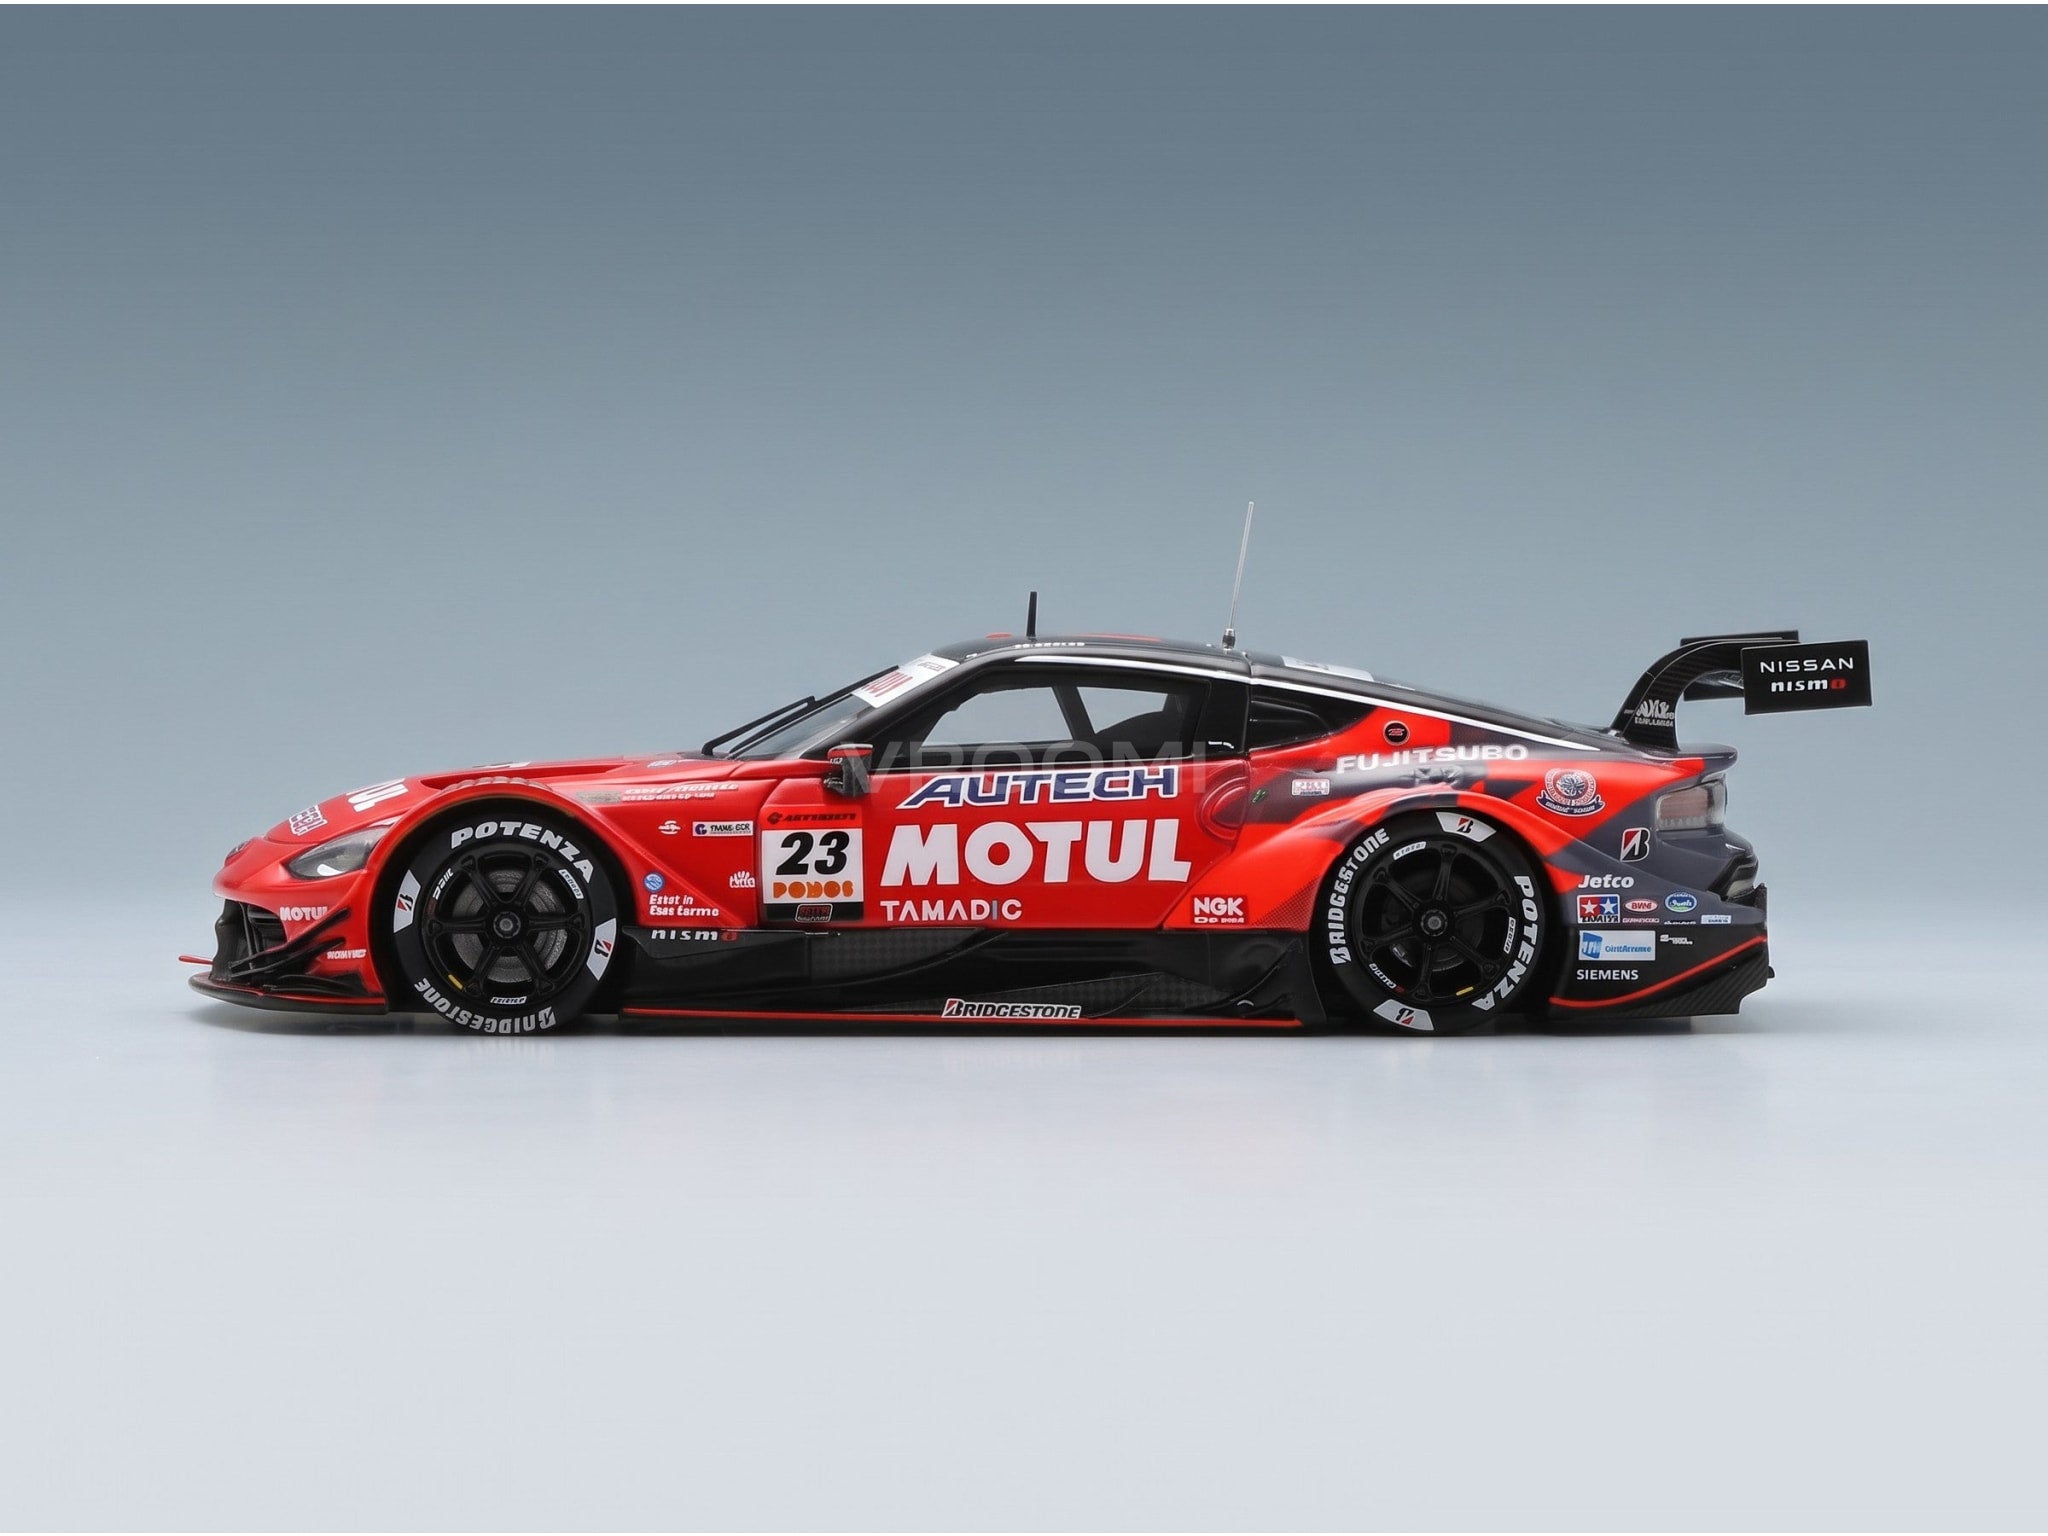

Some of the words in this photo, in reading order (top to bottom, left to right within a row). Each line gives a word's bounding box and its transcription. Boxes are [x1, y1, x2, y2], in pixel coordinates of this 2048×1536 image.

[1760, 657, 1854, 673] NISSAN
[1771, 679, 1846, 692] nismo
[1336, 744, 1528, 774] FUJITSUBO
[896, 766, 1178, 809] AUTECH
[451, 821, 594, 884] POTENZA
[775, 831, 850, 876] 23
[880, 819, 1192, 886] MOTUL
[880, 899, 1022, 921] TAMADIC
[1194, 897, 1244, 916] NGK
[1328, 828, 1391, 965] BRIDGESTONE
[1472, 875, 1538, 1011] POTENZA
[1576, 969, 1639, 980] SIEMENS
[414, 978, 556, 1034] BRIDGESTONE
[942, 999, 1081, 1019] BRIDGESTONE
